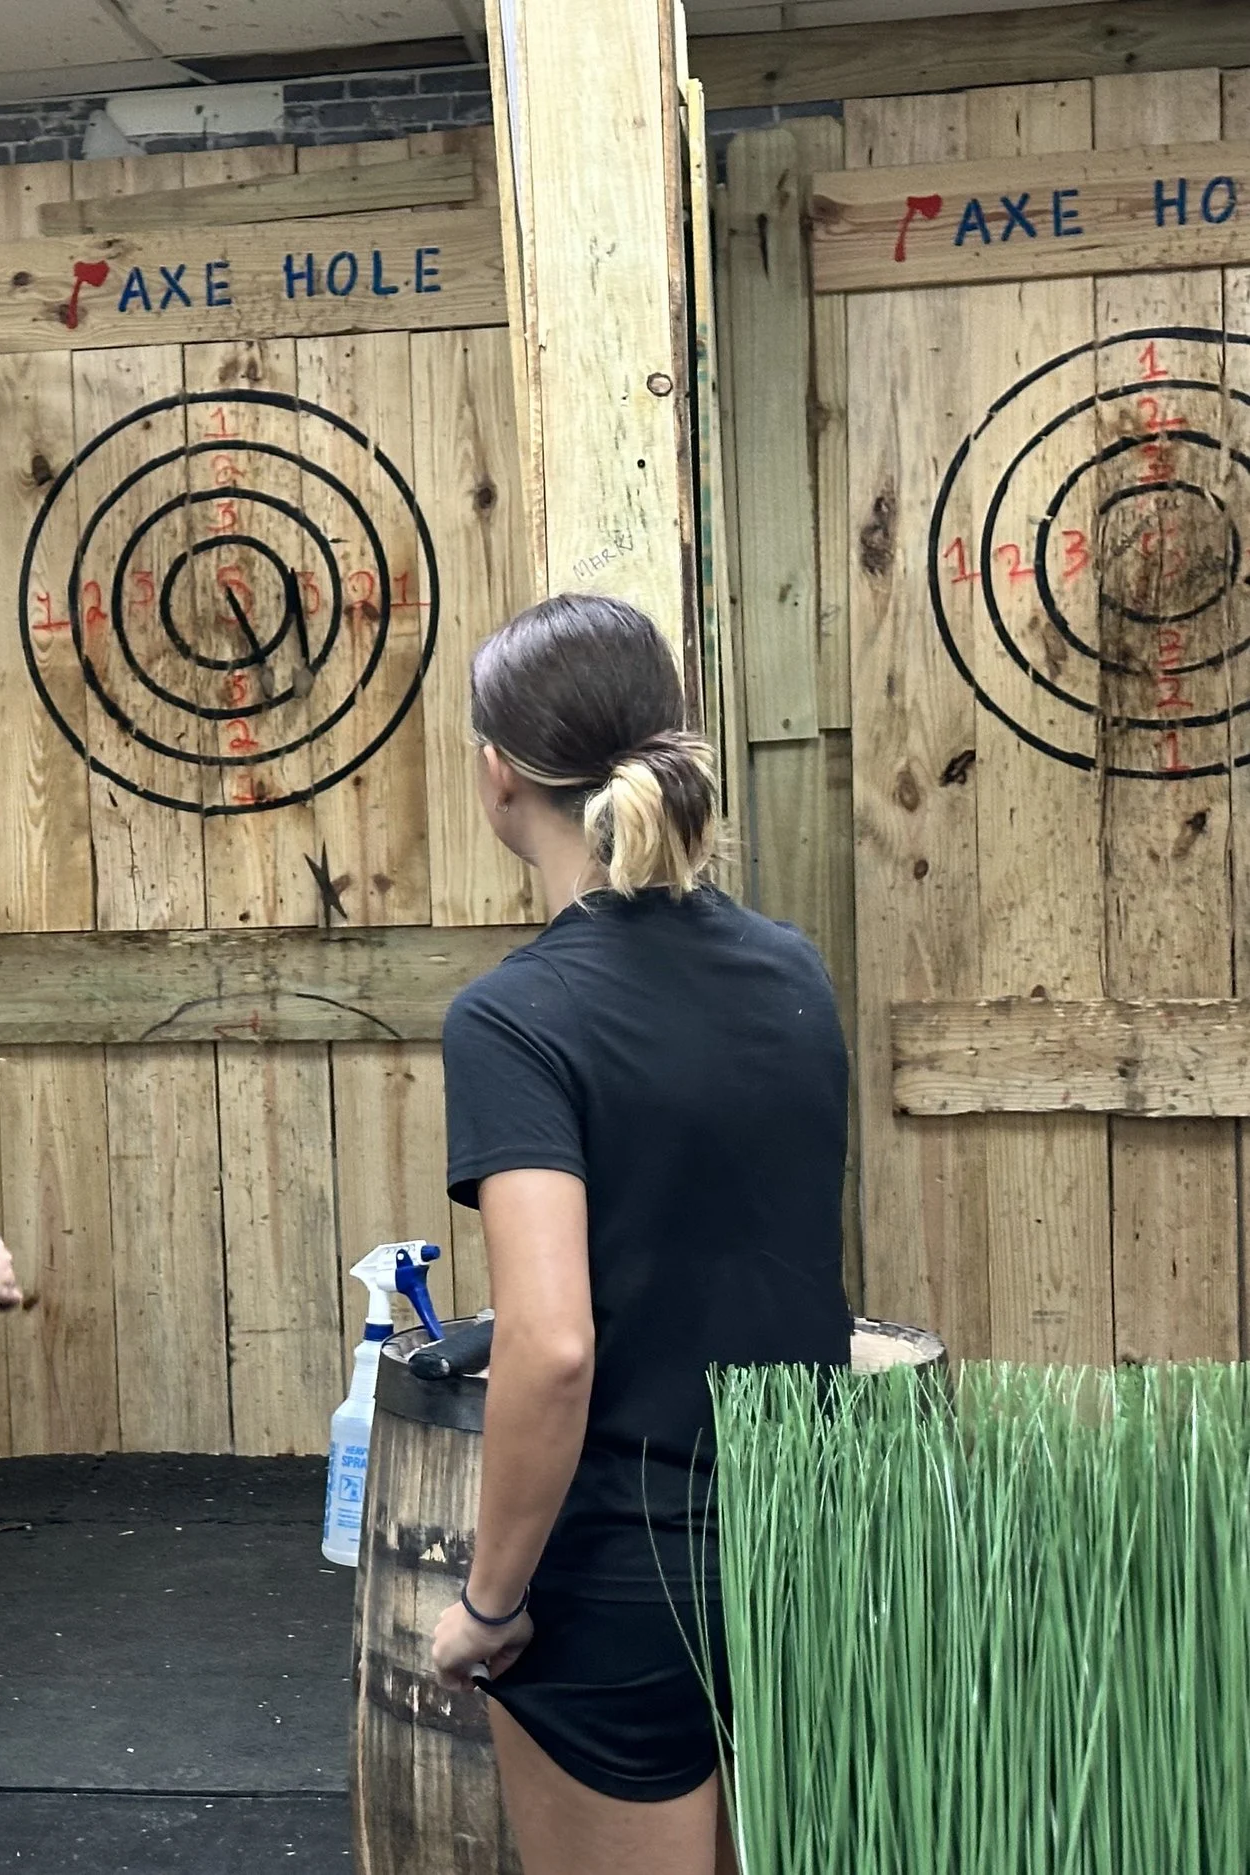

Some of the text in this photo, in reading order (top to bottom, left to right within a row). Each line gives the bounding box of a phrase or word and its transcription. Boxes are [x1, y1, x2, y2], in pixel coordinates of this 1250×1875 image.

[953, 188, 1083, 247] AXE
[117, 247, 442, 313] AXE HOLE
[1138, 341, 1169, 381] 1
[206, 407, 240, 438] 1
[1137, 396, 1187, 431] 2
[208, 501, 239, 532] 3
[942, 537, 982, 583] 1
[994, 544, 1036, 584] 2
[1061, 529, 1093, 579] 3
[32, 592, 71, 630] 1
[83, 580, 108, 625] 2
[1155, 677, 1194, 709] 2
[226, 718, 259, 751] 2
[1161, 731, 1193, 771] 1
[341, 1456, 368, 1469] SPRA
